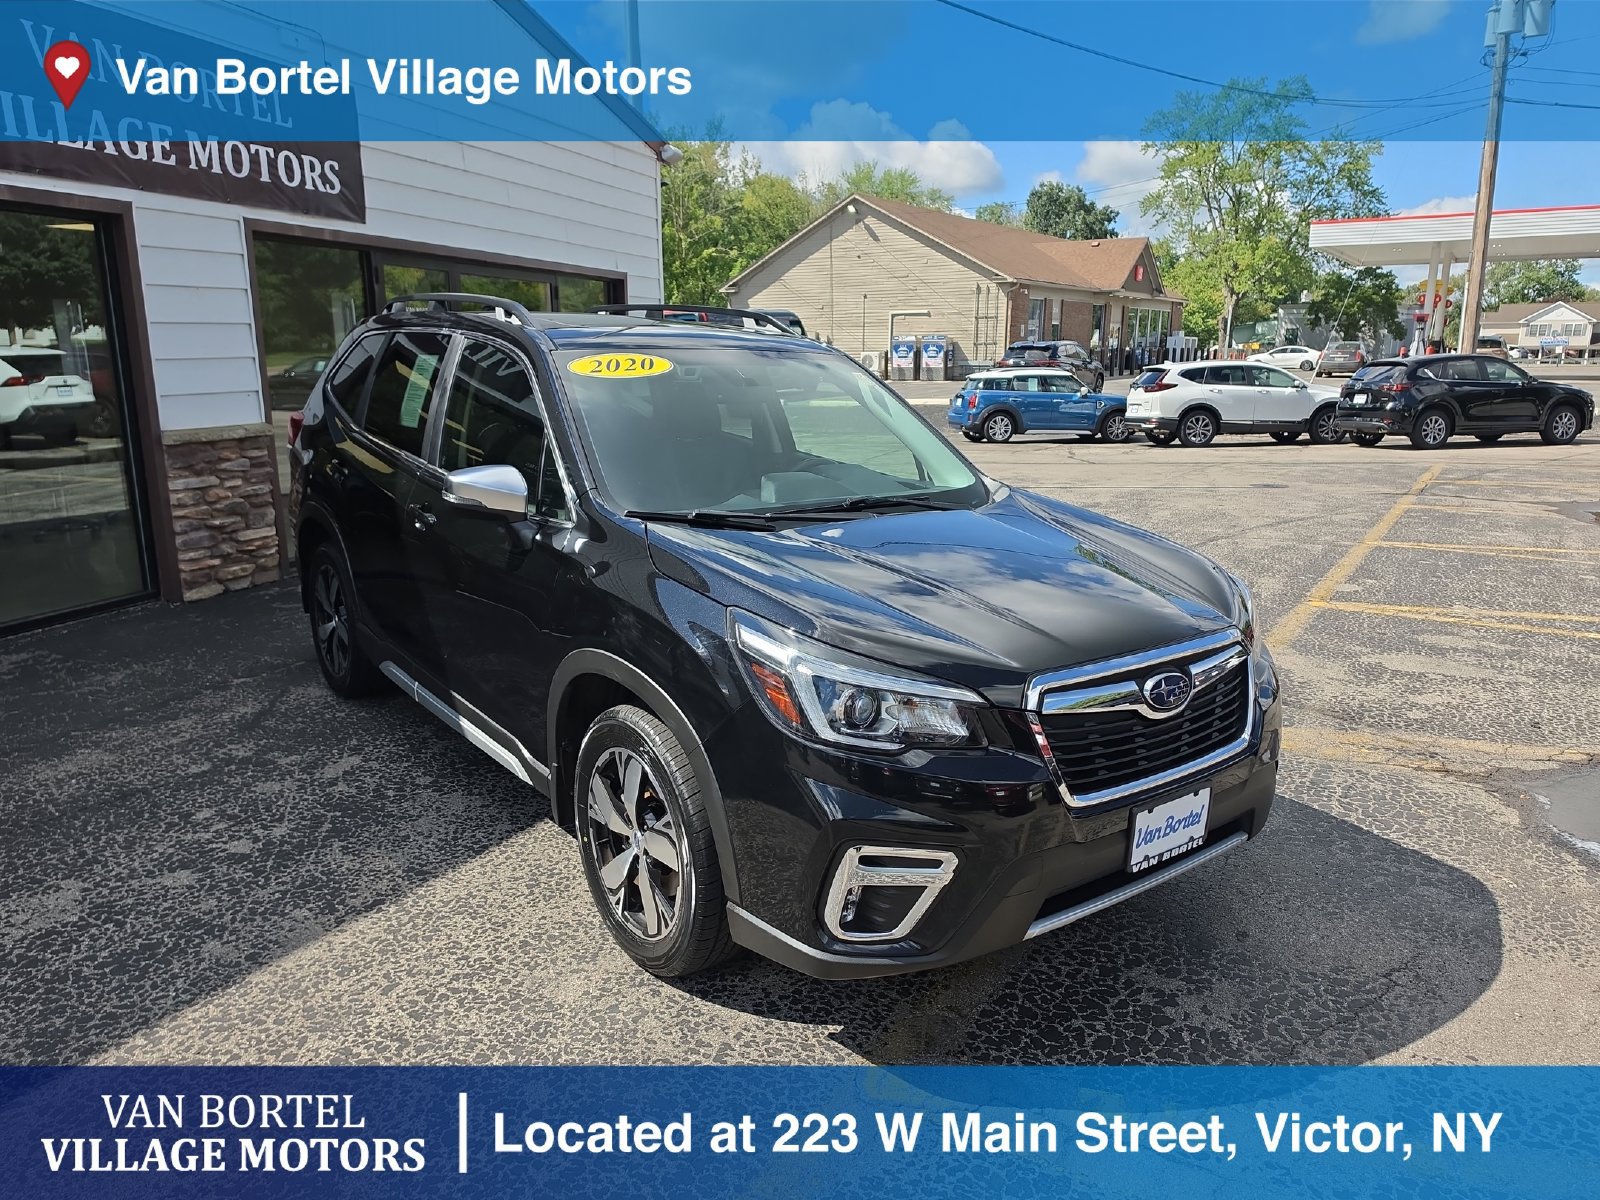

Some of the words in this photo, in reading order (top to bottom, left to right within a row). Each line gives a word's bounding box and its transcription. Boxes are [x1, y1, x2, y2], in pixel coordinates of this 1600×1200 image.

[0, 91, 176, 166] ILLAGE
[185, 129, 341, 194] MOTORS
[589, 357, 655, 374] 2020
[1132, 855, 1159, 873] VAN
[1162, 837, 1204, 861] BORTEL
